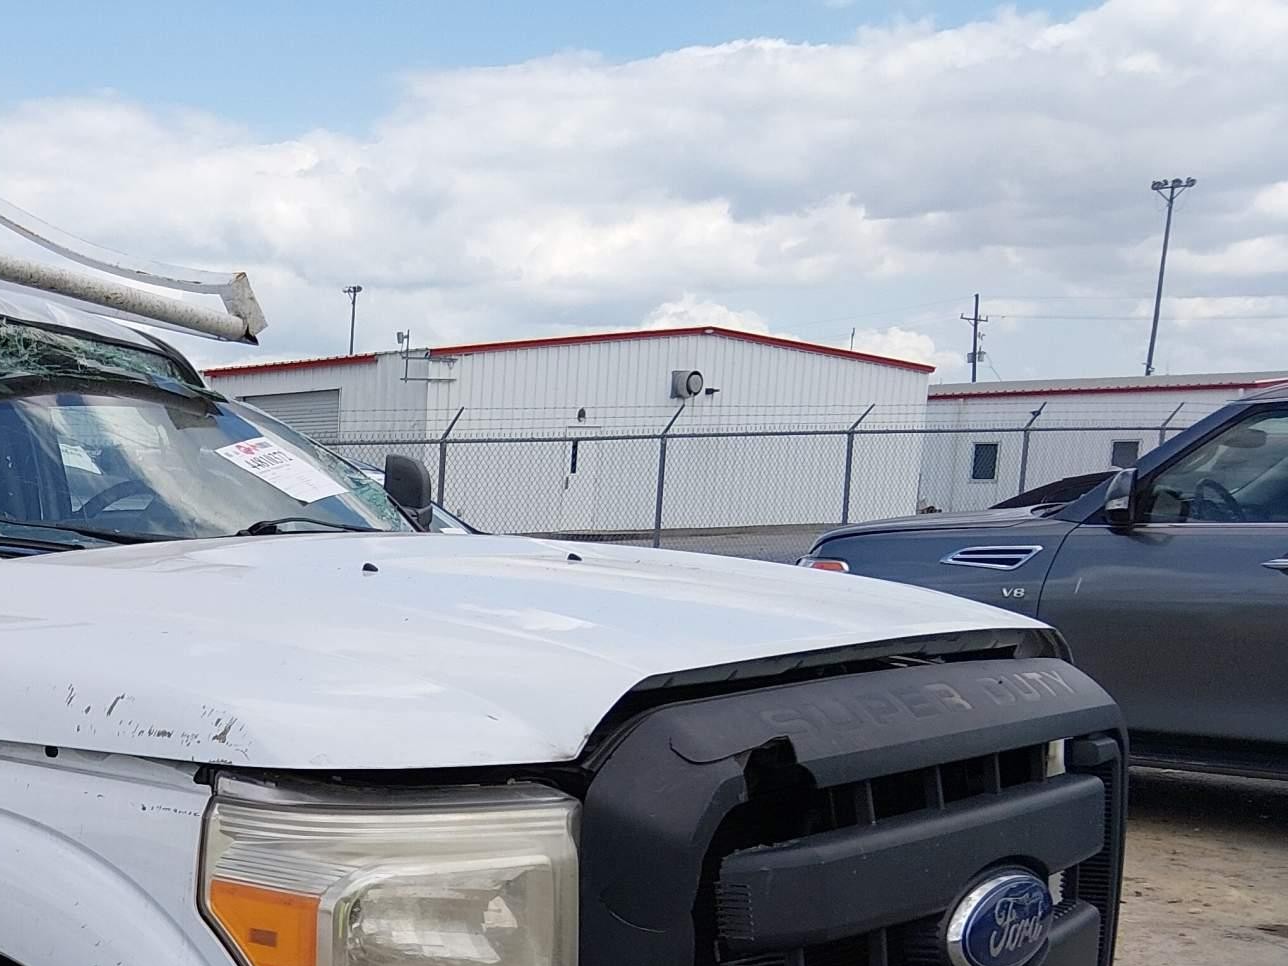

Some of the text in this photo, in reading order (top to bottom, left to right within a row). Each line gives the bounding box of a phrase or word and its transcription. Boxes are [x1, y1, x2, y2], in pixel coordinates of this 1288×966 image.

[1001, 587, 1025, 598] V8
[760, 669, 1077, 737] SUPER DUTY
[989, 883, 1046, 958] Ford
